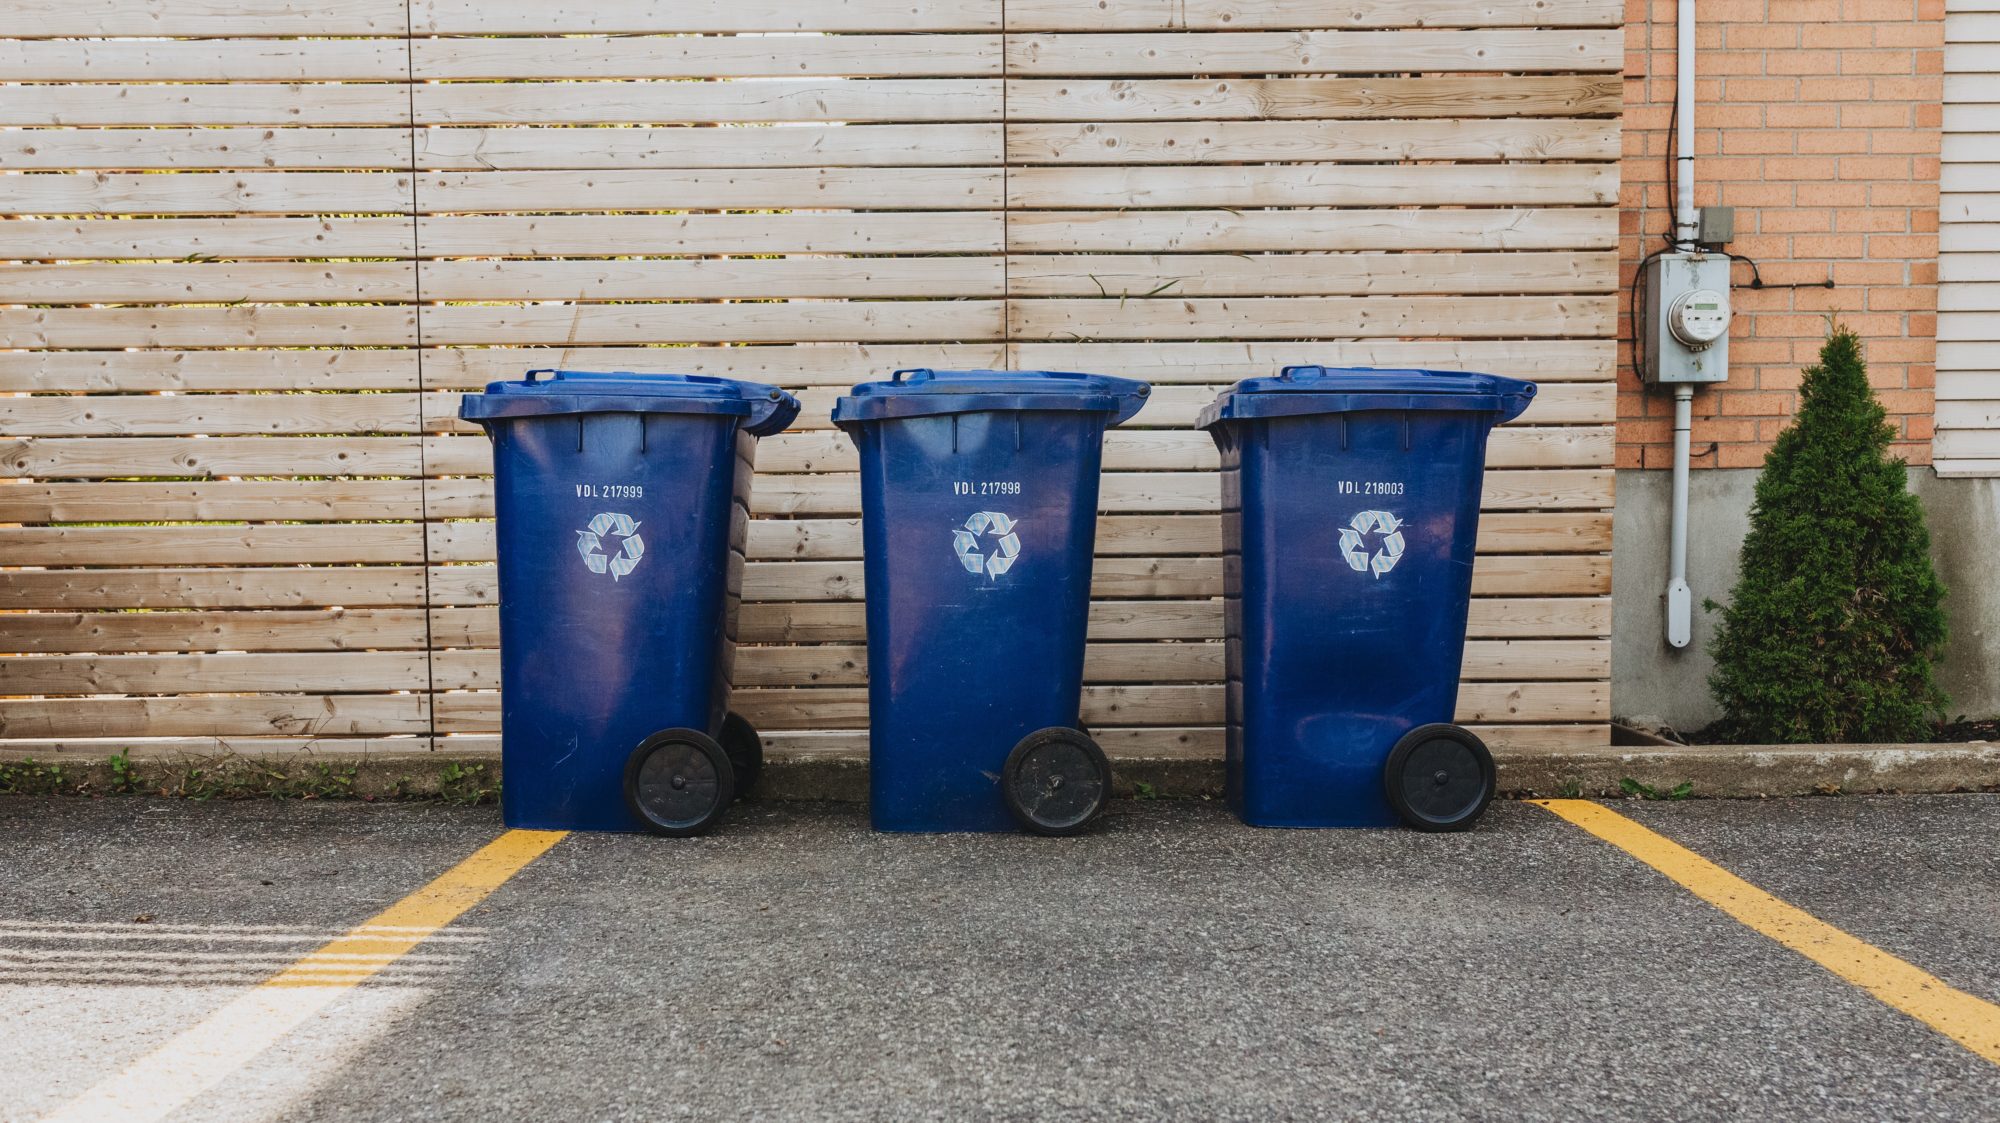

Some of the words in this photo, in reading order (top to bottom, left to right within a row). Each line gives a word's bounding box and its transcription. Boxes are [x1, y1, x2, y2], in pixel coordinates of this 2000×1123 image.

[576, 484, 598, 498] VDL
[602, 485, 643, 498] 217999
[954, 481, 976, 495] VDL
[981, 482, 1021, 495] 217998
[1338, 481, 1360, 494] VDL
[1365, 481, 1404, 495] 218003
